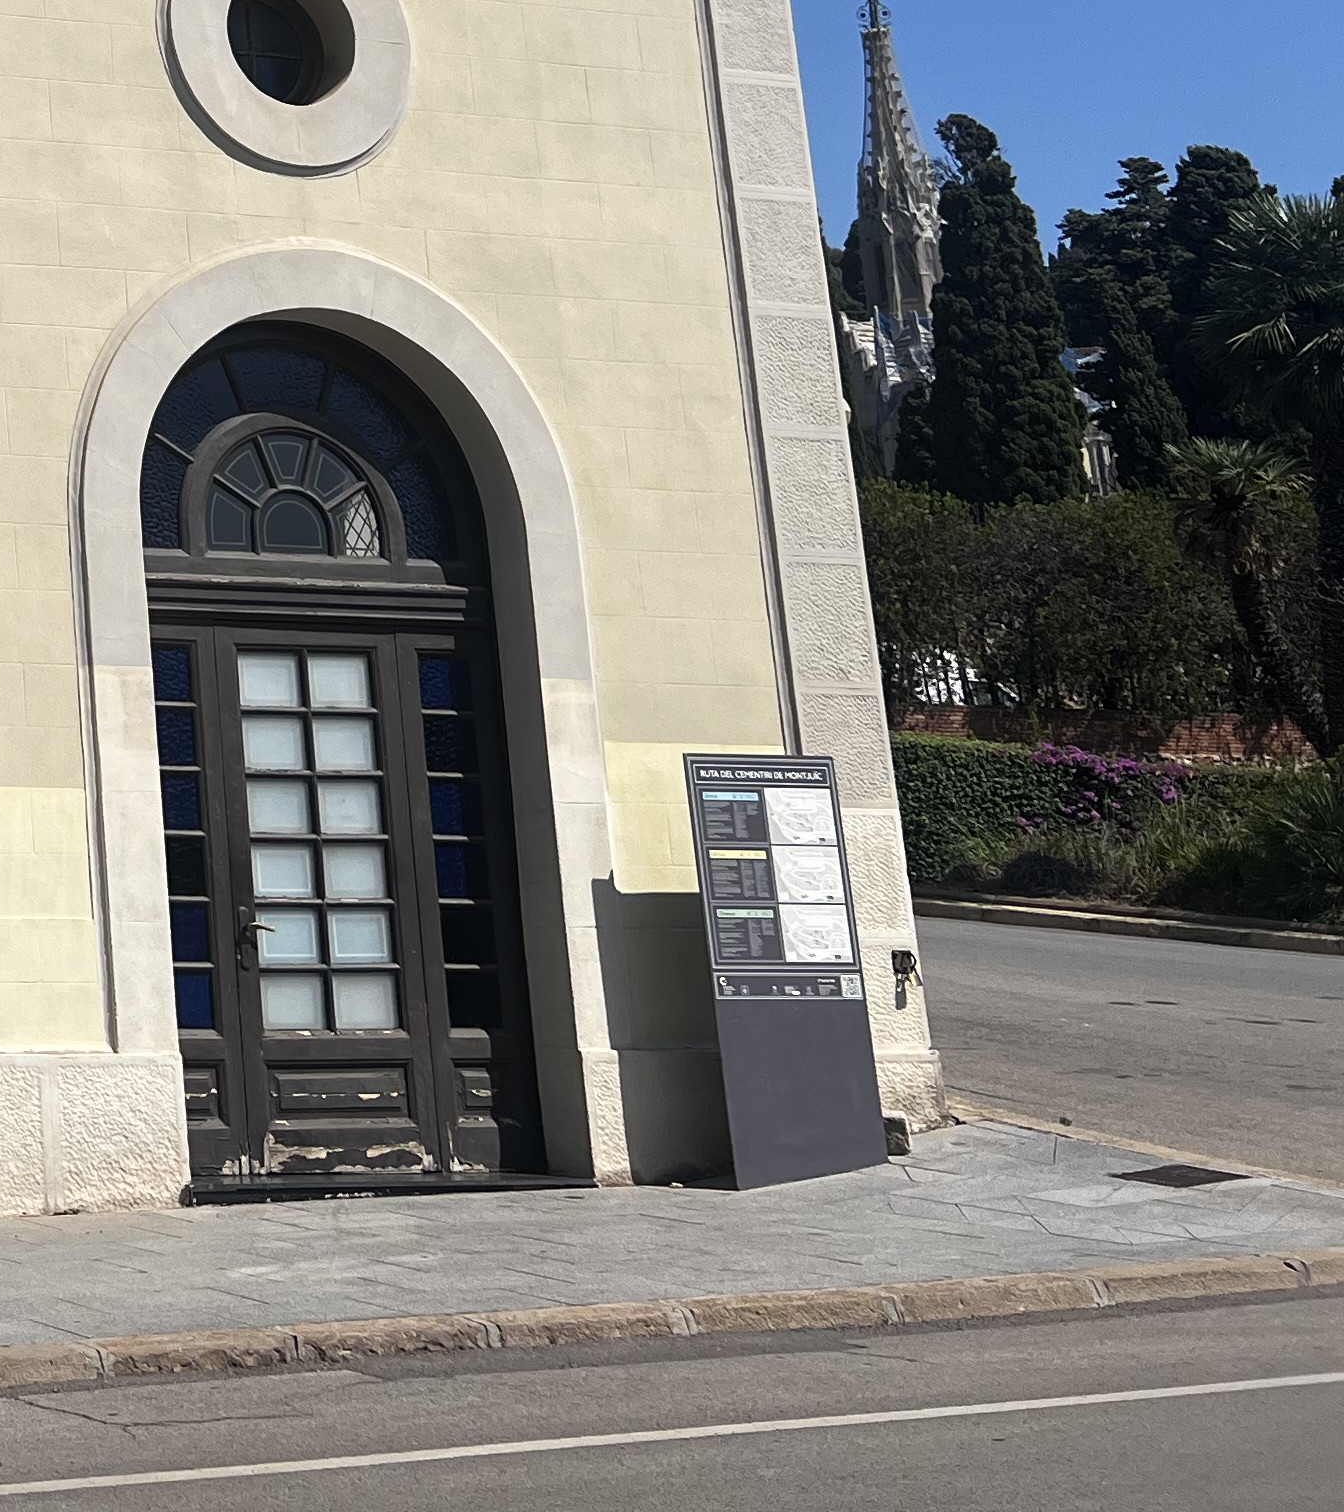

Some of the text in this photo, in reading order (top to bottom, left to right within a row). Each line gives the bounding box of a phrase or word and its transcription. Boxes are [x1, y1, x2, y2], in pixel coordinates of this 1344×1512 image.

[700, 769, 719, 778] RUTA
[720, 770, 733, 779] DEL
[735, 770, 772, 780] CEMENTIRI
[774, 771, 784, 780] DE
